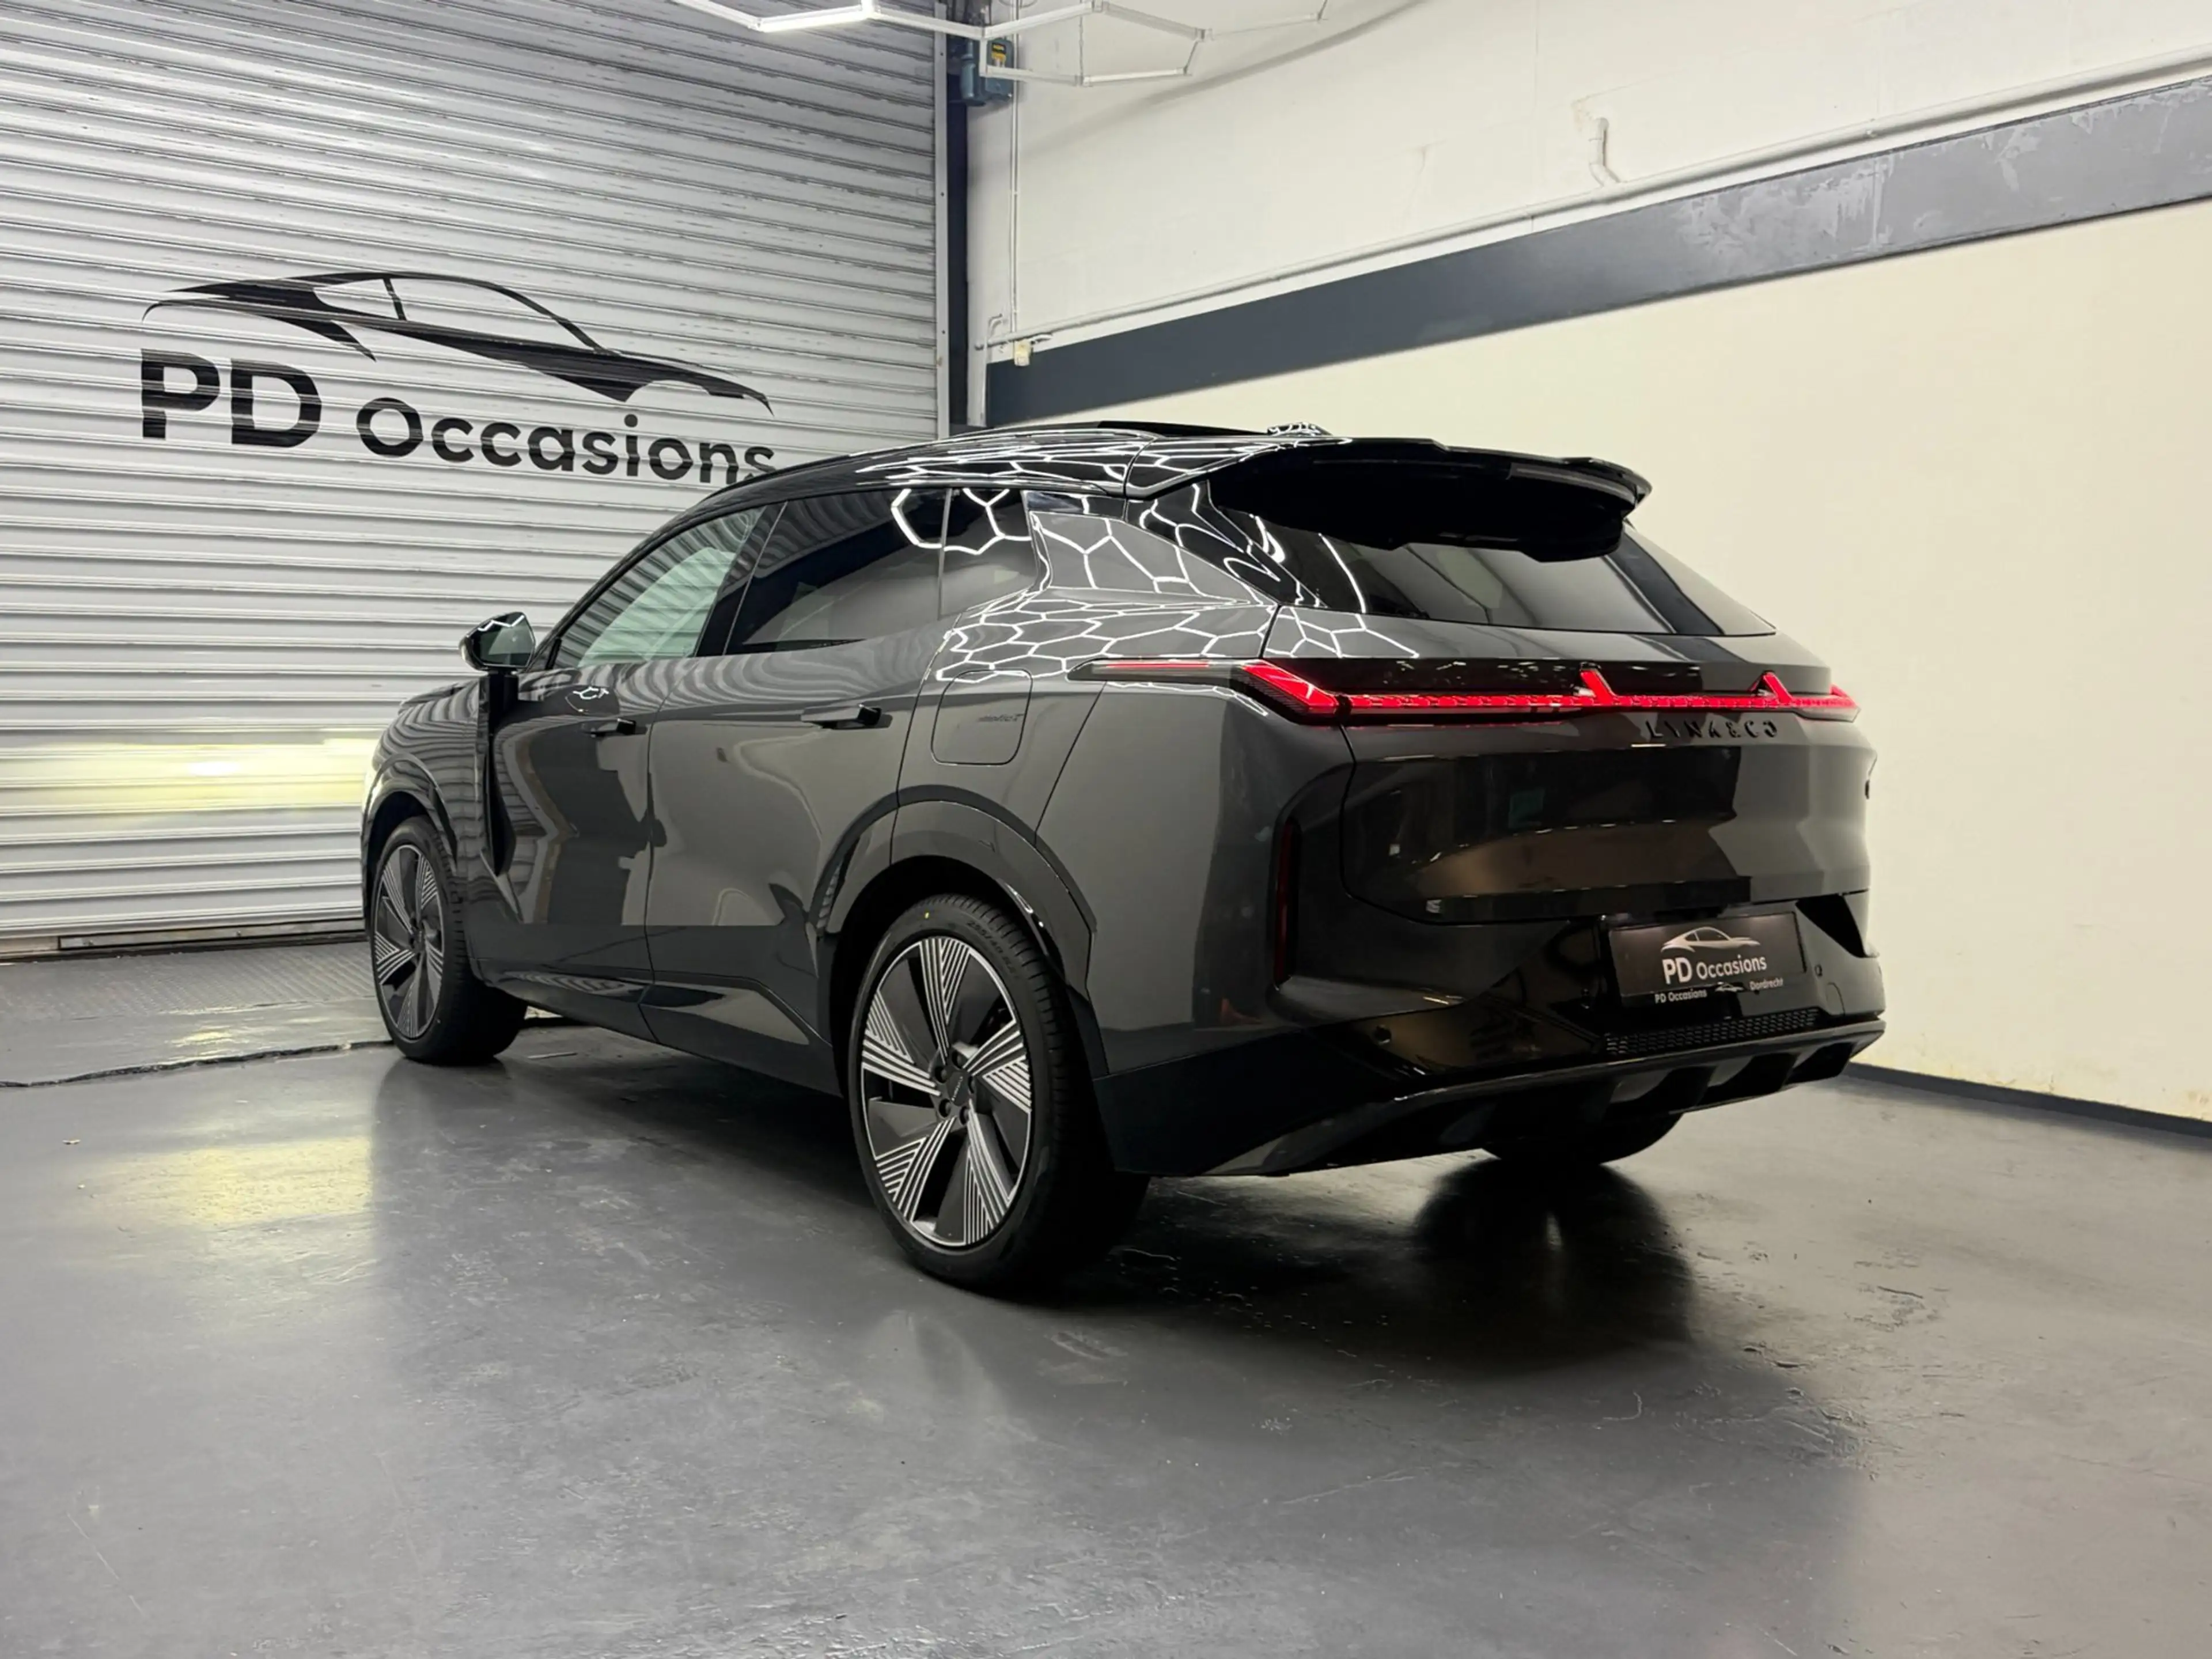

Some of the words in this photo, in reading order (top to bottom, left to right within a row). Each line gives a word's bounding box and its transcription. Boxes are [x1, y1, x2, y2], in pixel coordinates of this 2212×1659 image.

[141, 349, 322, 448] PD
[356, 397, 777, 485] Occasions
[1662, 957, 1692, 984] PD
[1696, 951, 1767, 980] Occasions
[1654, 993, 1666, 1003] PD
[1668, 988, 1707, 1002] Occasions
[1749, 978, 1784, 990] Dordrecht
